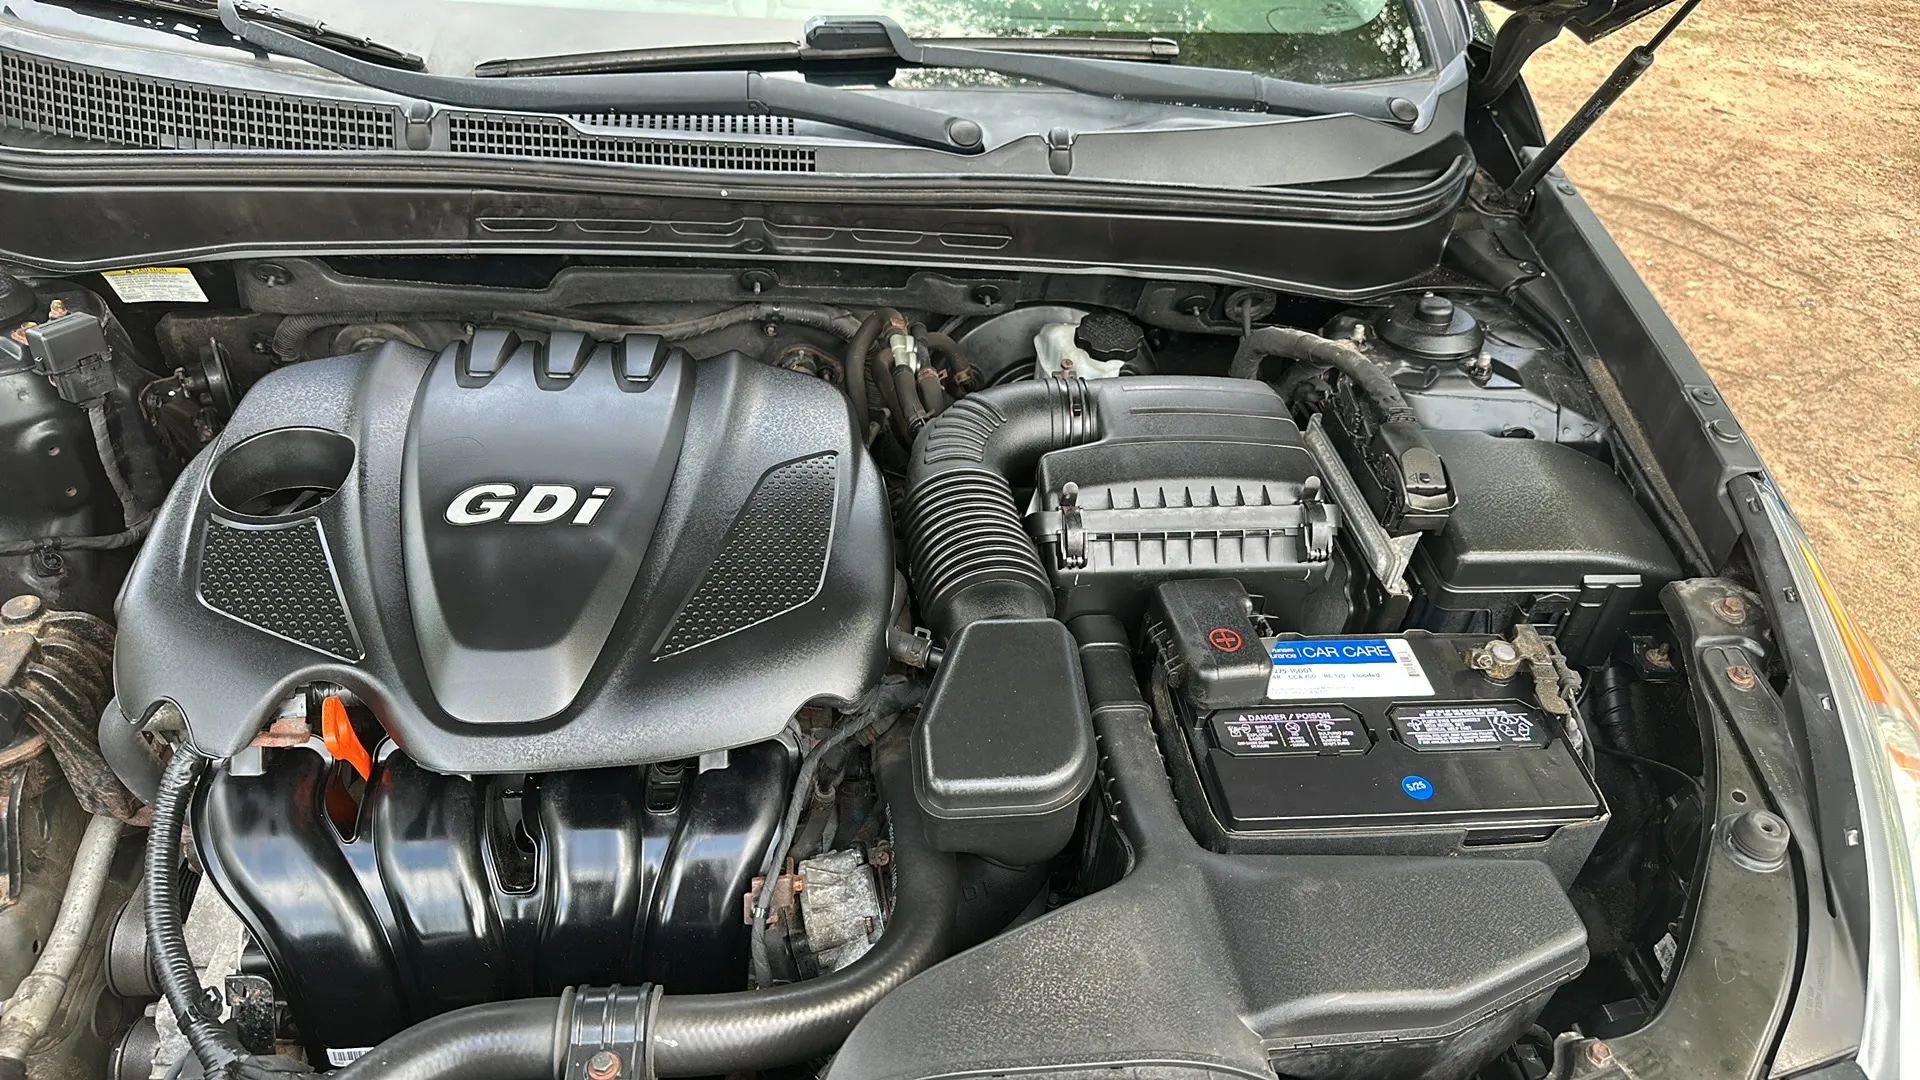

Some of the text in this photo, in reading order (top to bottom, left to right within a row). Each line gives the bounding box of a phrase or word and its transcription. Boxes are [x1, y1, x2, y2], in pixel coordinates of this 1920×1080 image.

[443, 482, 615, 526] GDi
[1303, 645, 1391, 658] CAR CARE
[1296, 712, 1332, 720] POISON
[1406, 781, 1427, 792] 5/25
